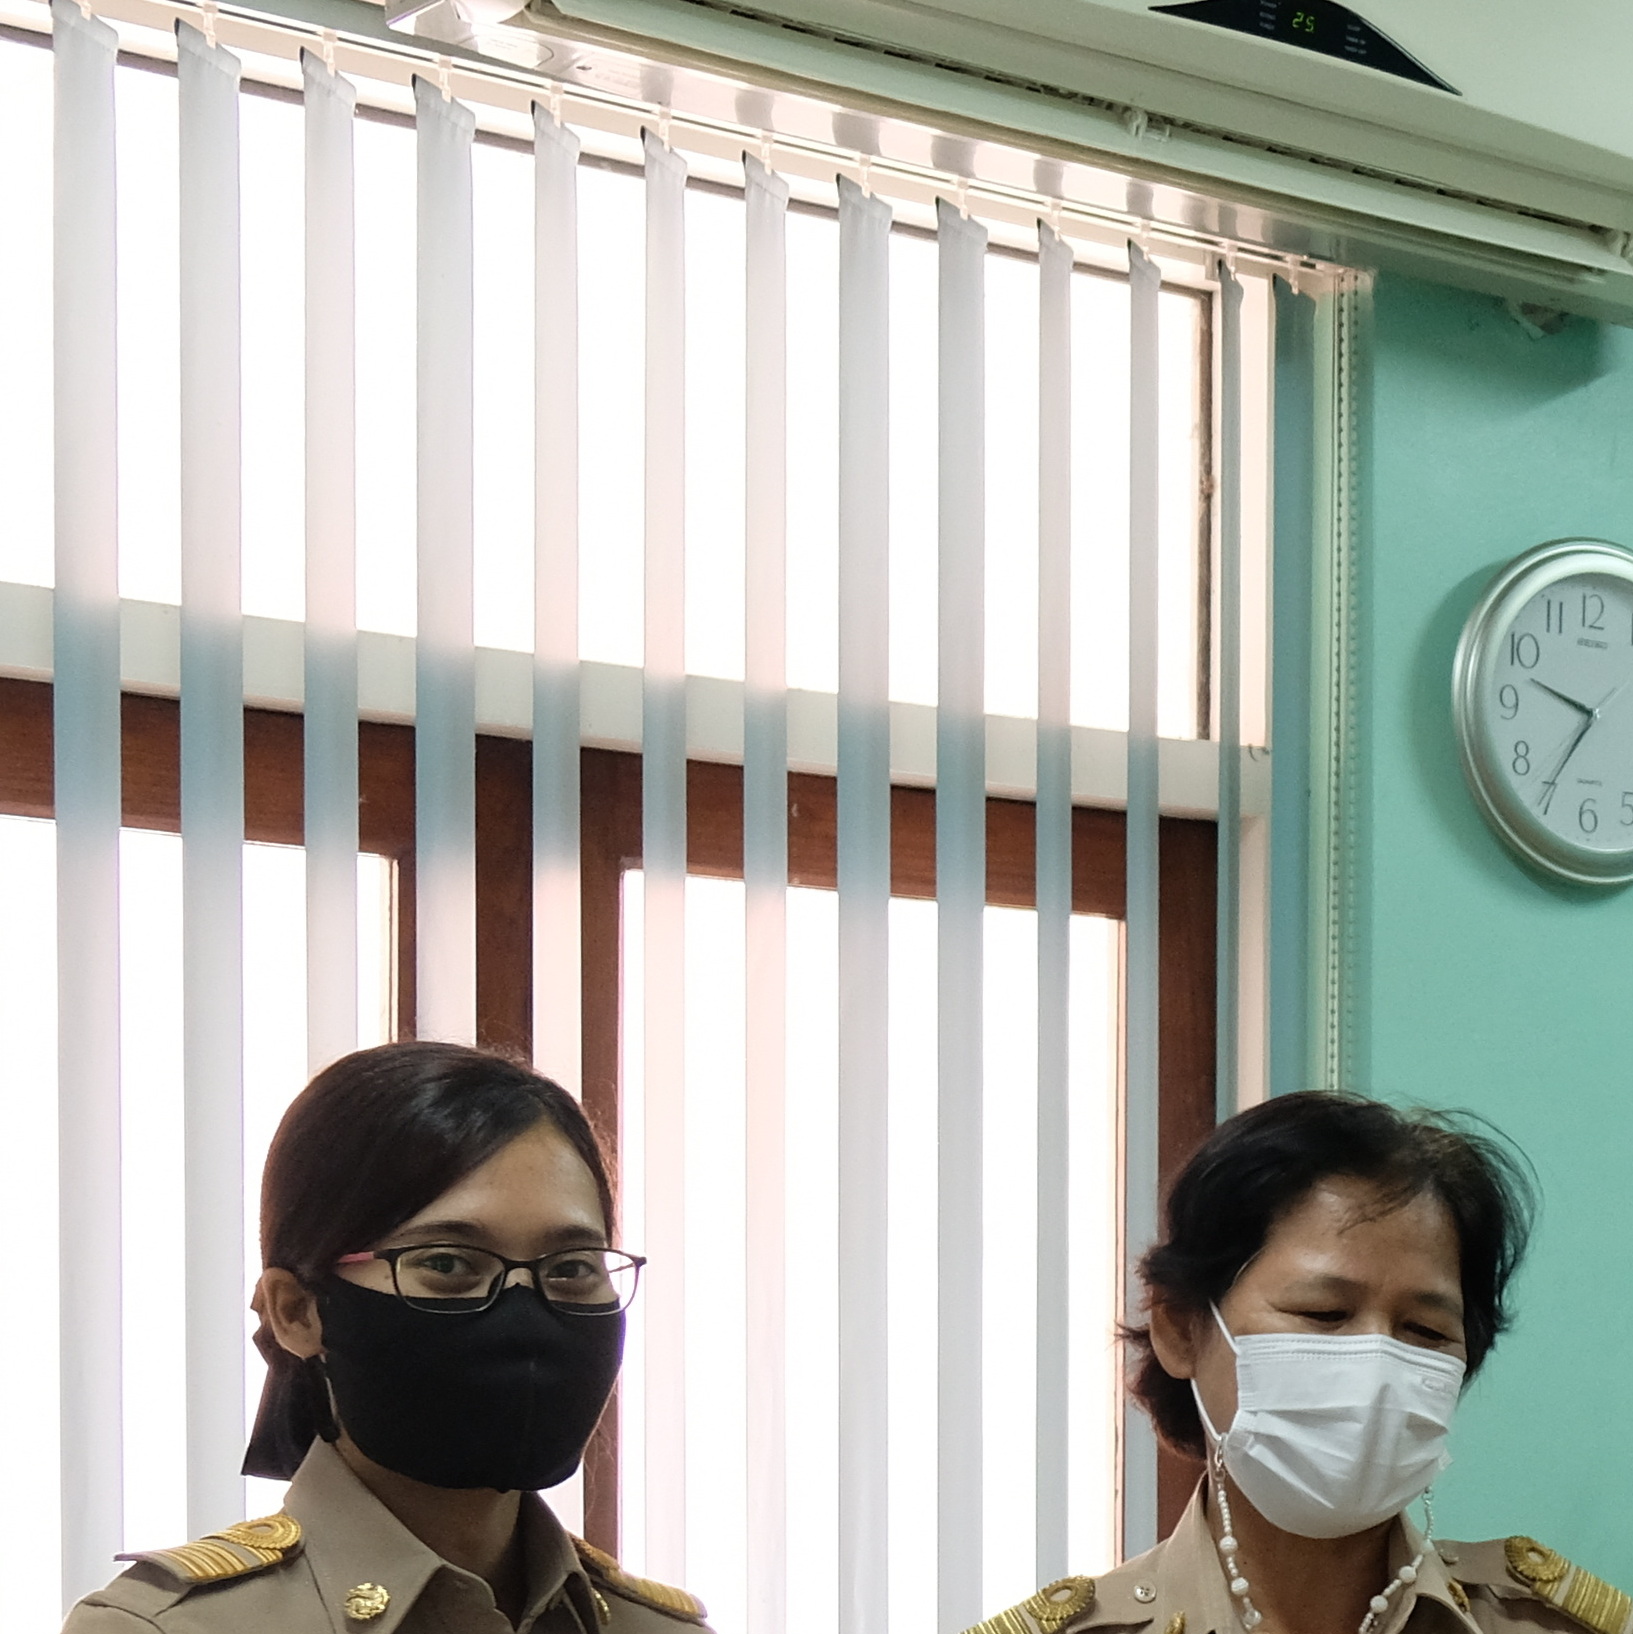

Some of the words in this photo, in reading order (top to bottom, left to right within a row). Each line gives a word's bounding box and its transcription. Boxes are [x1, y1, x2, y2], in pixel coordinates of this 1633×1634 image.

[1292, 12, 1315, 33] 25
[1546, 599, 1563, 634] 11
[1582, 594, 1604, 630] 12
[1510, 631, 1540, 669] 10
[1499, 684, 1519, 720] 9
[1512, 740, 1531, 776] 8
[1541, 780, 1557, 815] 7
[1578, 798, 1598, 834] 6
